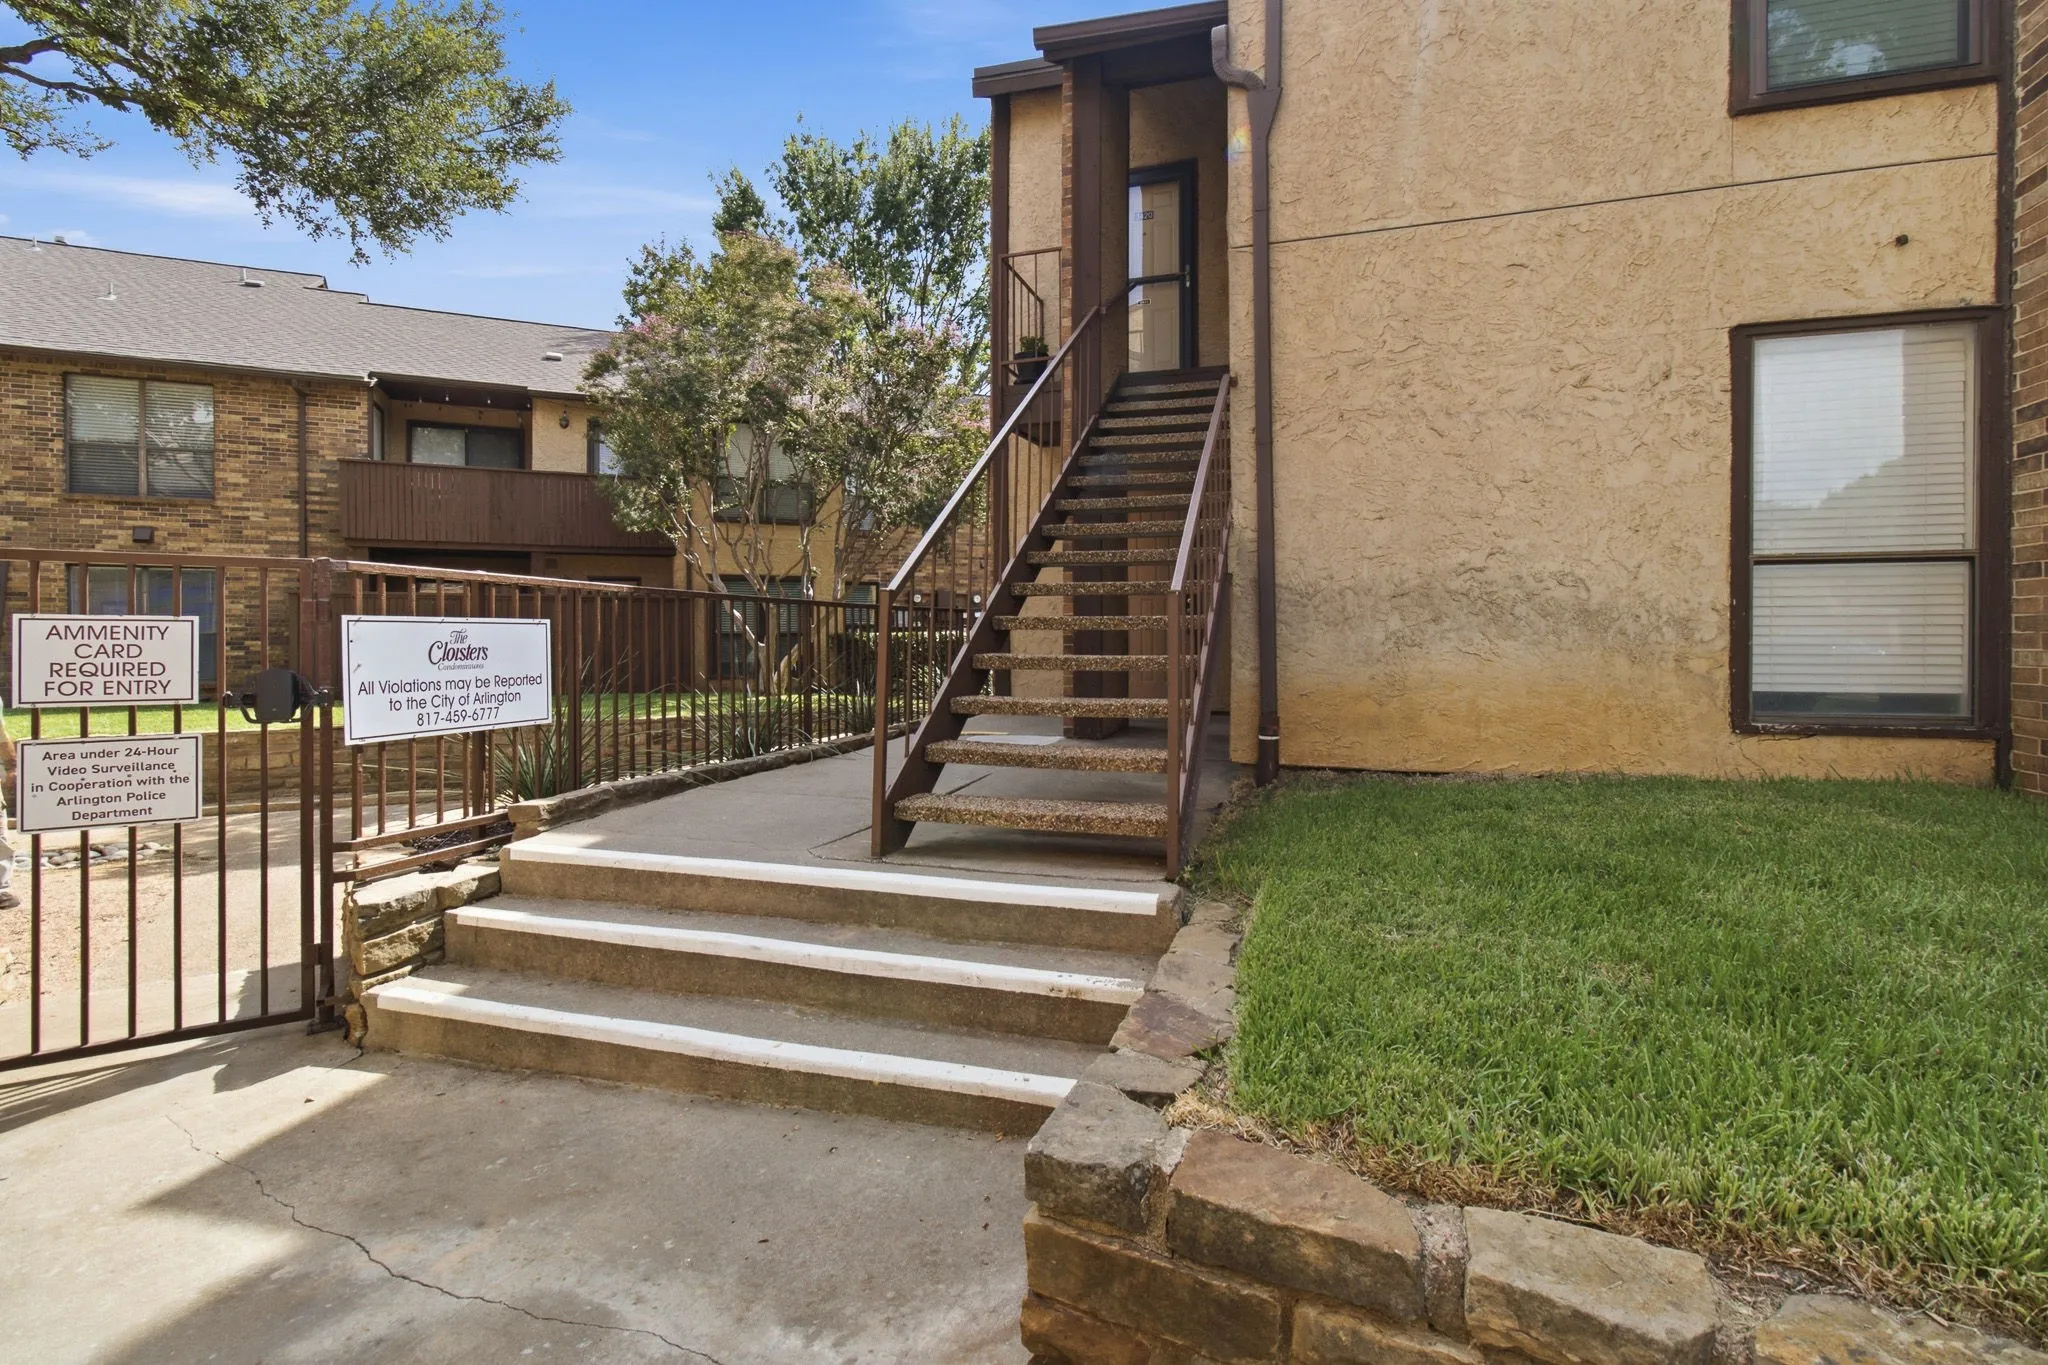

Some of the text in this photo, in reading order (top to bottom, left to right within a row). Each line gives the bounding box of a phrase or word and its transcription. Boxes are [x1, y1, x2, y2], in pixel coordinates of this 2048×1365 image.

[45, 624, 169, 641] AMMENITY
[450, 628, 468, 644] The
[74, 643, 143, 659] CARD
[428, 640, 488, 665] Cloisters
[49, 661, 166, 678] REQUIRED
[44, 679, 171, 697] FOR ENTRY
[358, 673, 543, 695] All Violations may be Reported
[389, 690, 521, 712] to the City of Arlington
[417, 706, 500, 726] 817-459-6777
[42, 746, 180, 762] Area under 24-Hour
[48, 761, 175, 776] Video Surveillance
[31, 774, 190, 793] in Cooperation with the
[56, 790, 166, 808] Arlington Police
[72, 806, 153, 822] Department
